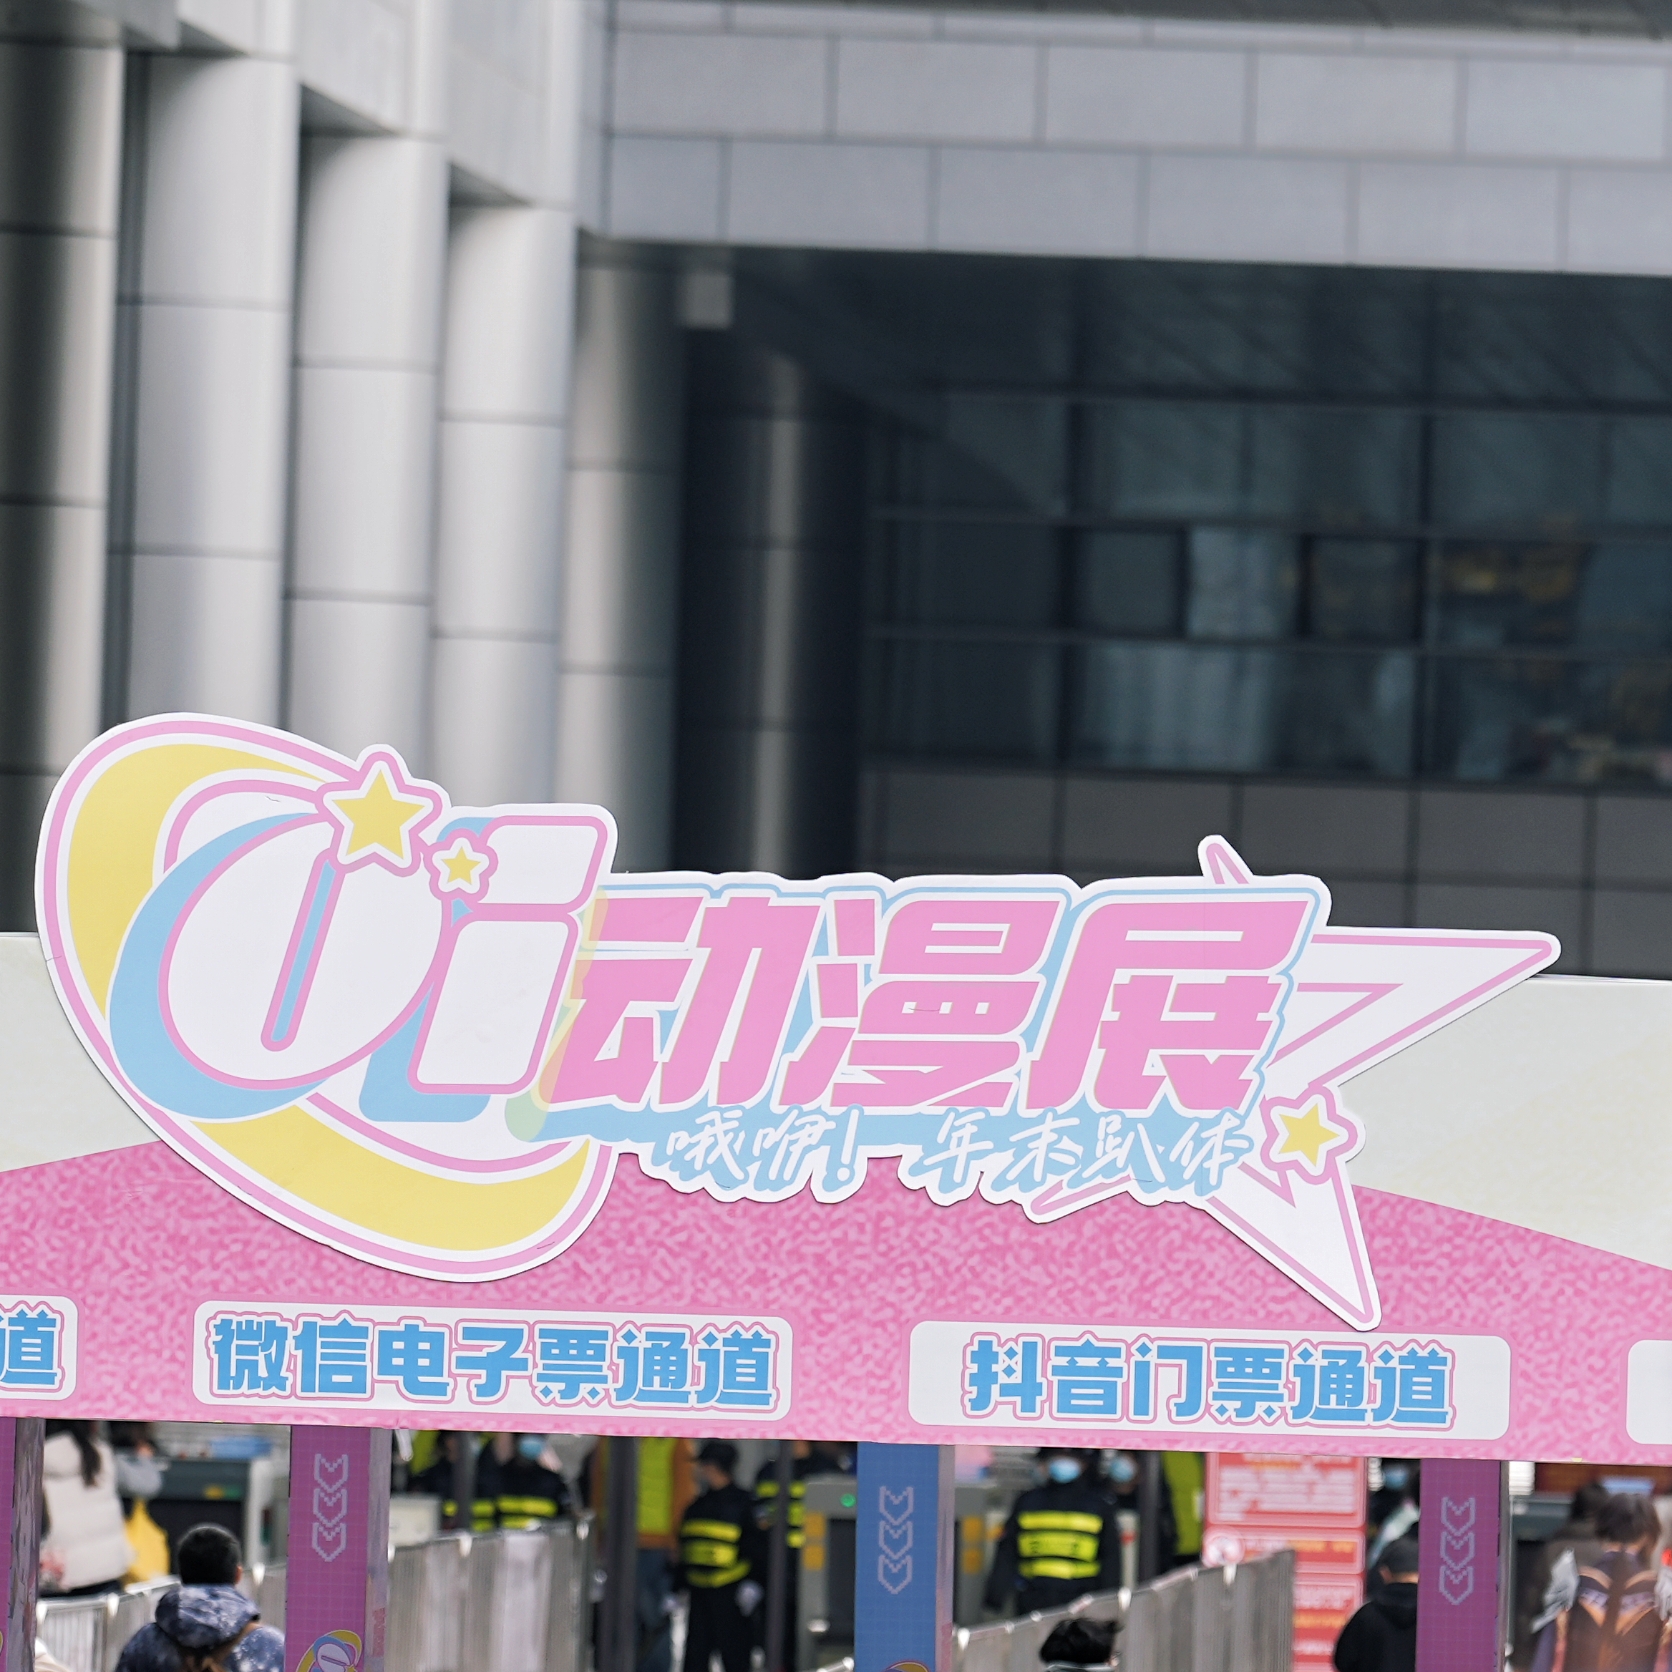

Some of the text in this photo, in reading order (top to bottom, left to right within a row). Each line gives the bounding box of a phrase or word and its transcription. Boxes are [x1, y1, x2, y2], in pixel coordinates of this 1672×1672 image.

[210, 1315, 775, 1408] 微信电子票通道
[968, 1335, 1454, 1427] 抖音门票通道
